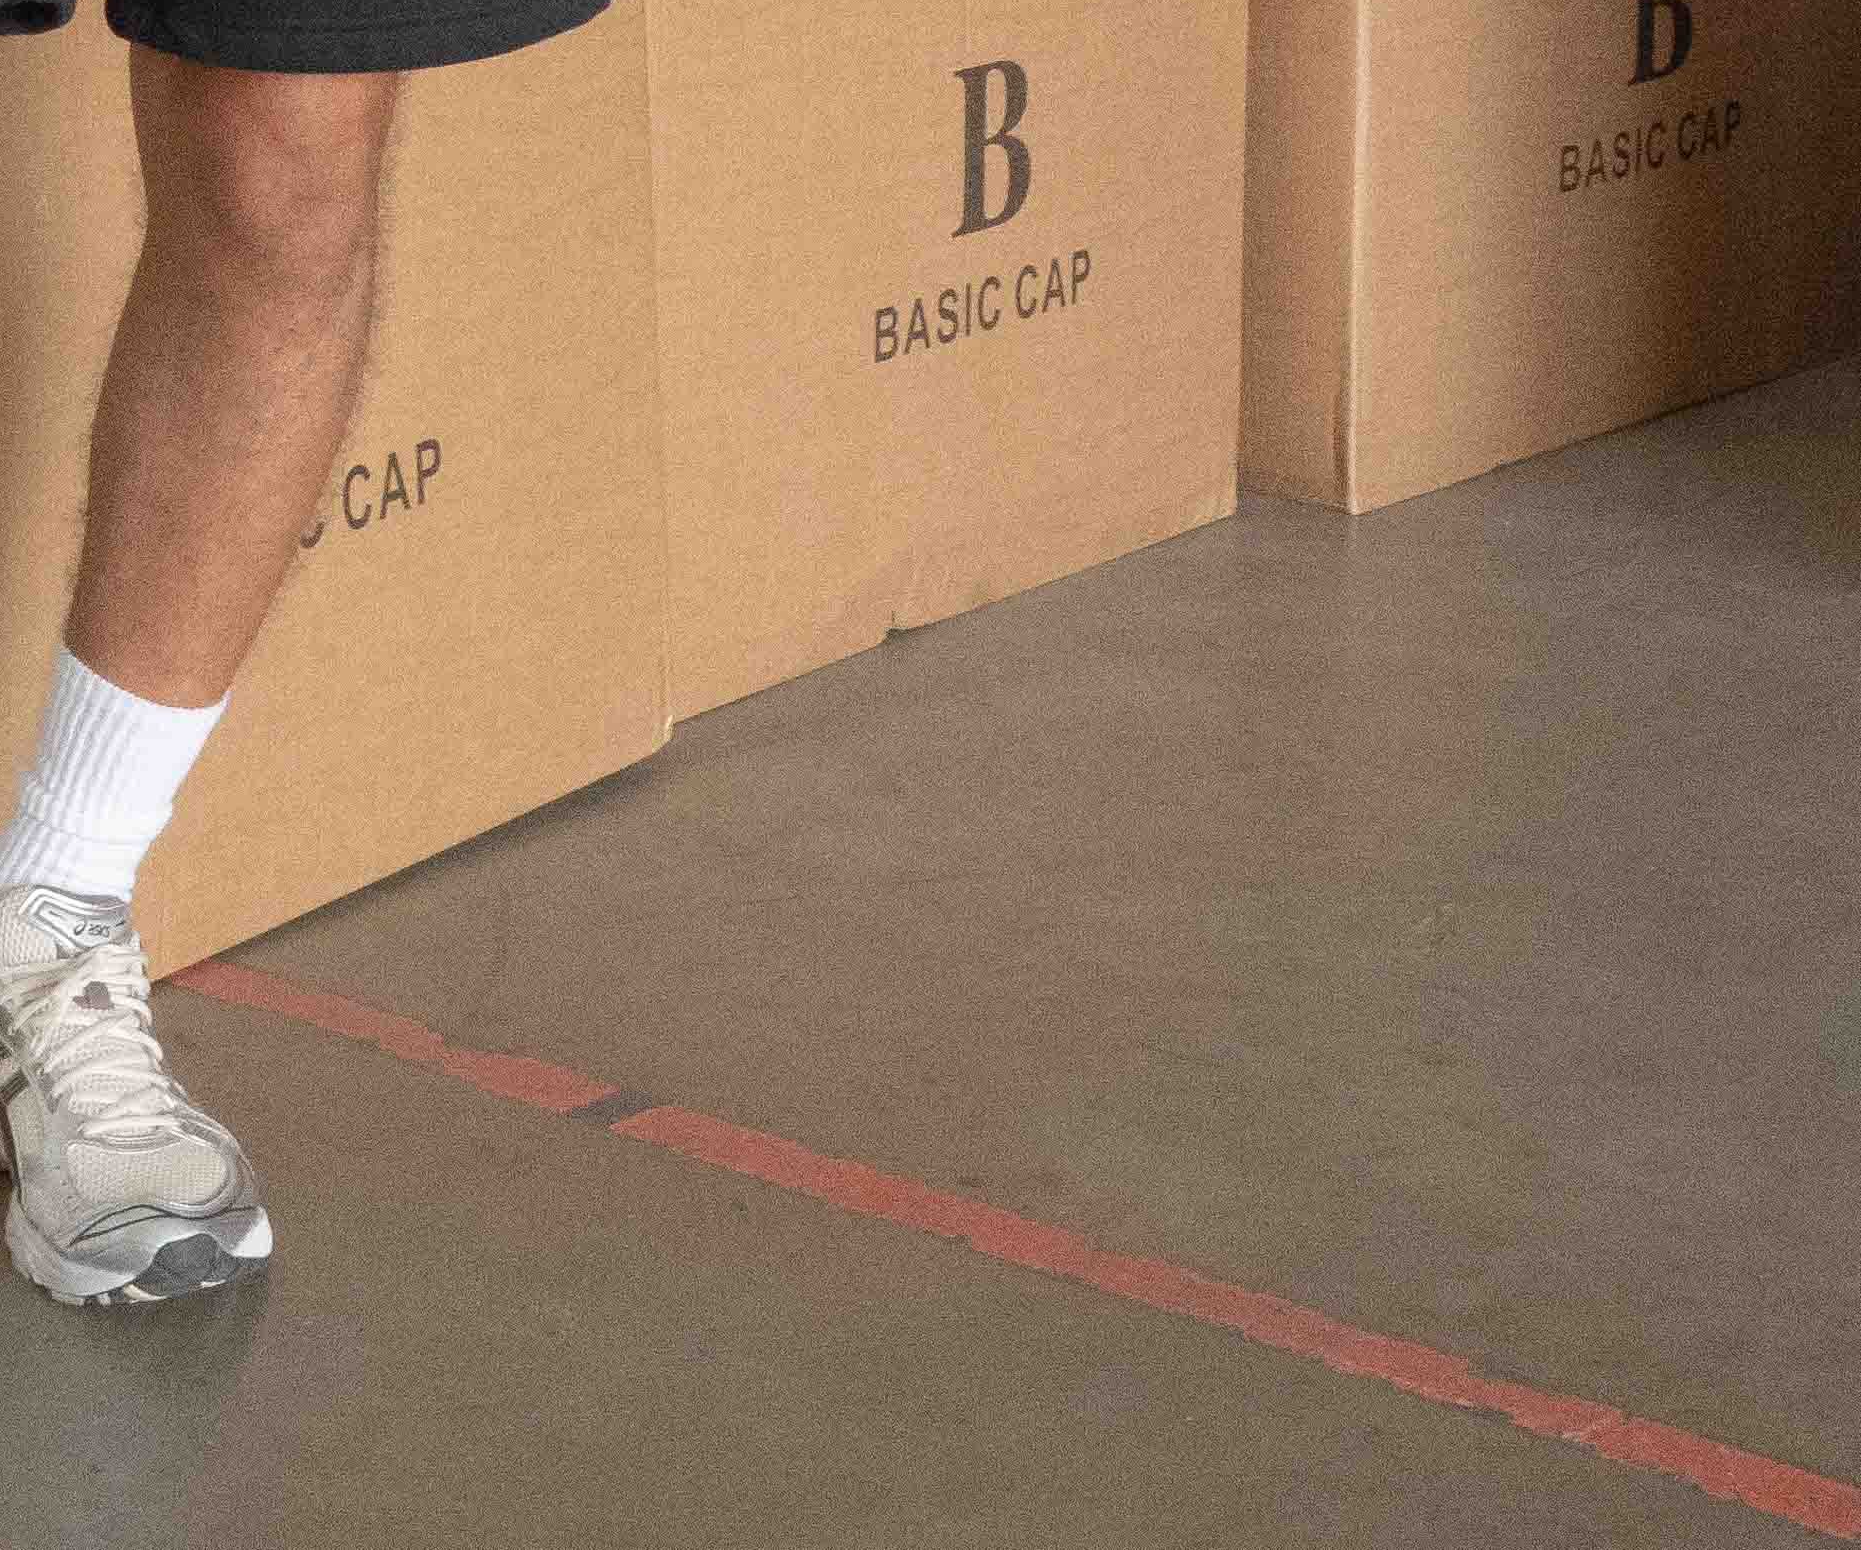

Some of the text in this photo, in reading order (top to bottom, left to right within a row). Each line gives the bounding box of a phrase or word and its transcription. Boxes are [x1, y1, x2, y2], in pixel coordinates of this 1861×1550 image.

[952, 60, 1031, 239] B
[1559, 99, 1742, 192] BASIC CAP
[875, 250, 1091, 364] BASIC CAP
[342, 439, 441, 530] CAP
